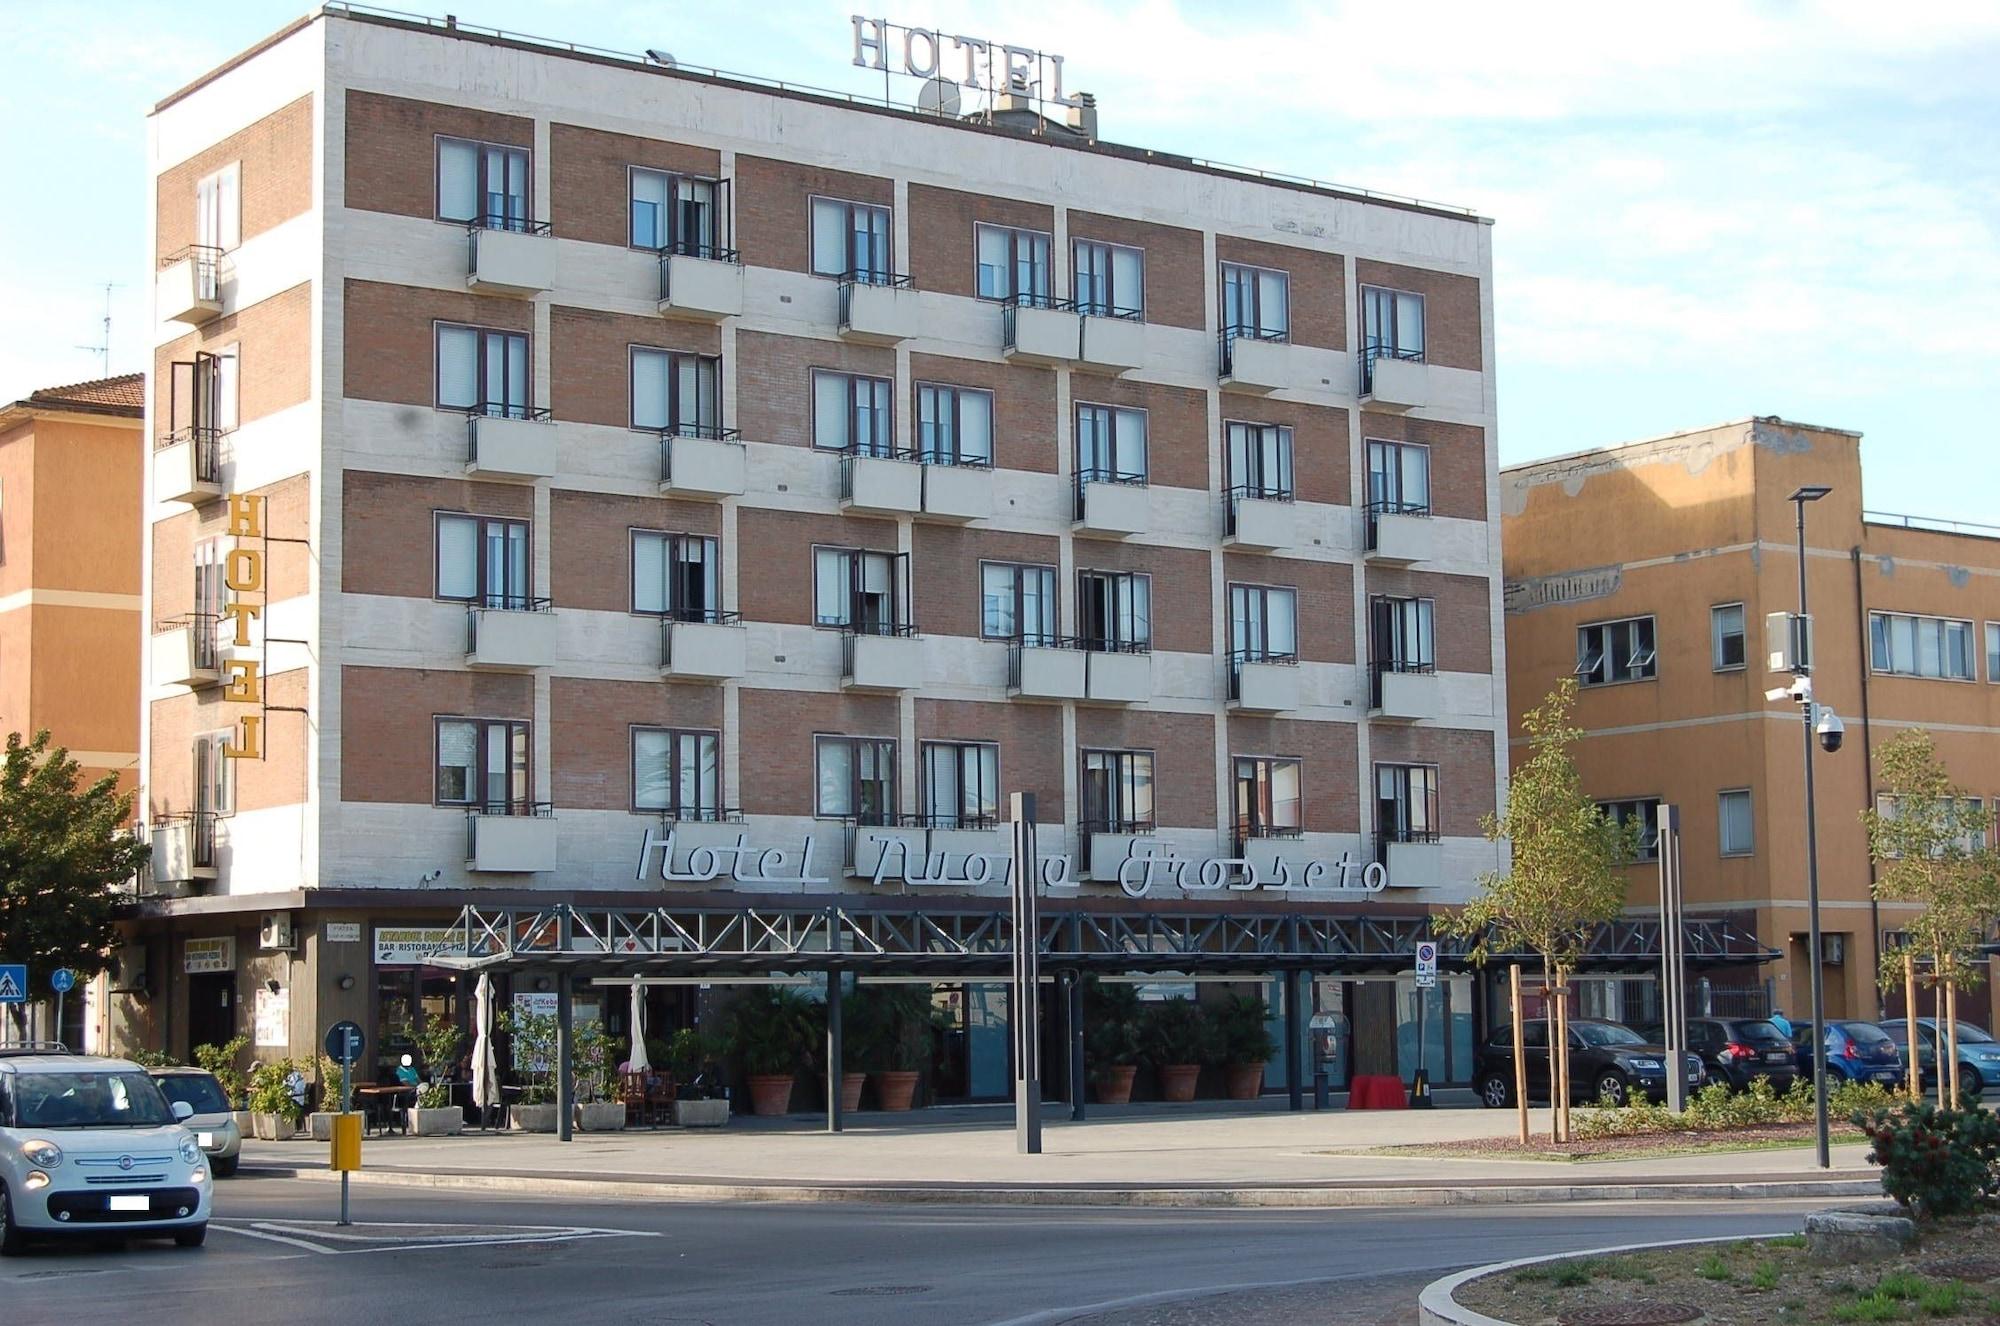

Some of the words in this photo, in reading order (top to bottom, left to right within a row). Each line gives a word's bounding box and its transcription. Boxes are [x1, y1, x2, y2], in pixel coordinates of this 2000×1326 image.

[851, 15, 1084, 107] HOTEL
[636, 829, 829, 884] Hotel
[1118, 838, 1387, 897] Grosseto
[379, 943, 394, 951] BAR
